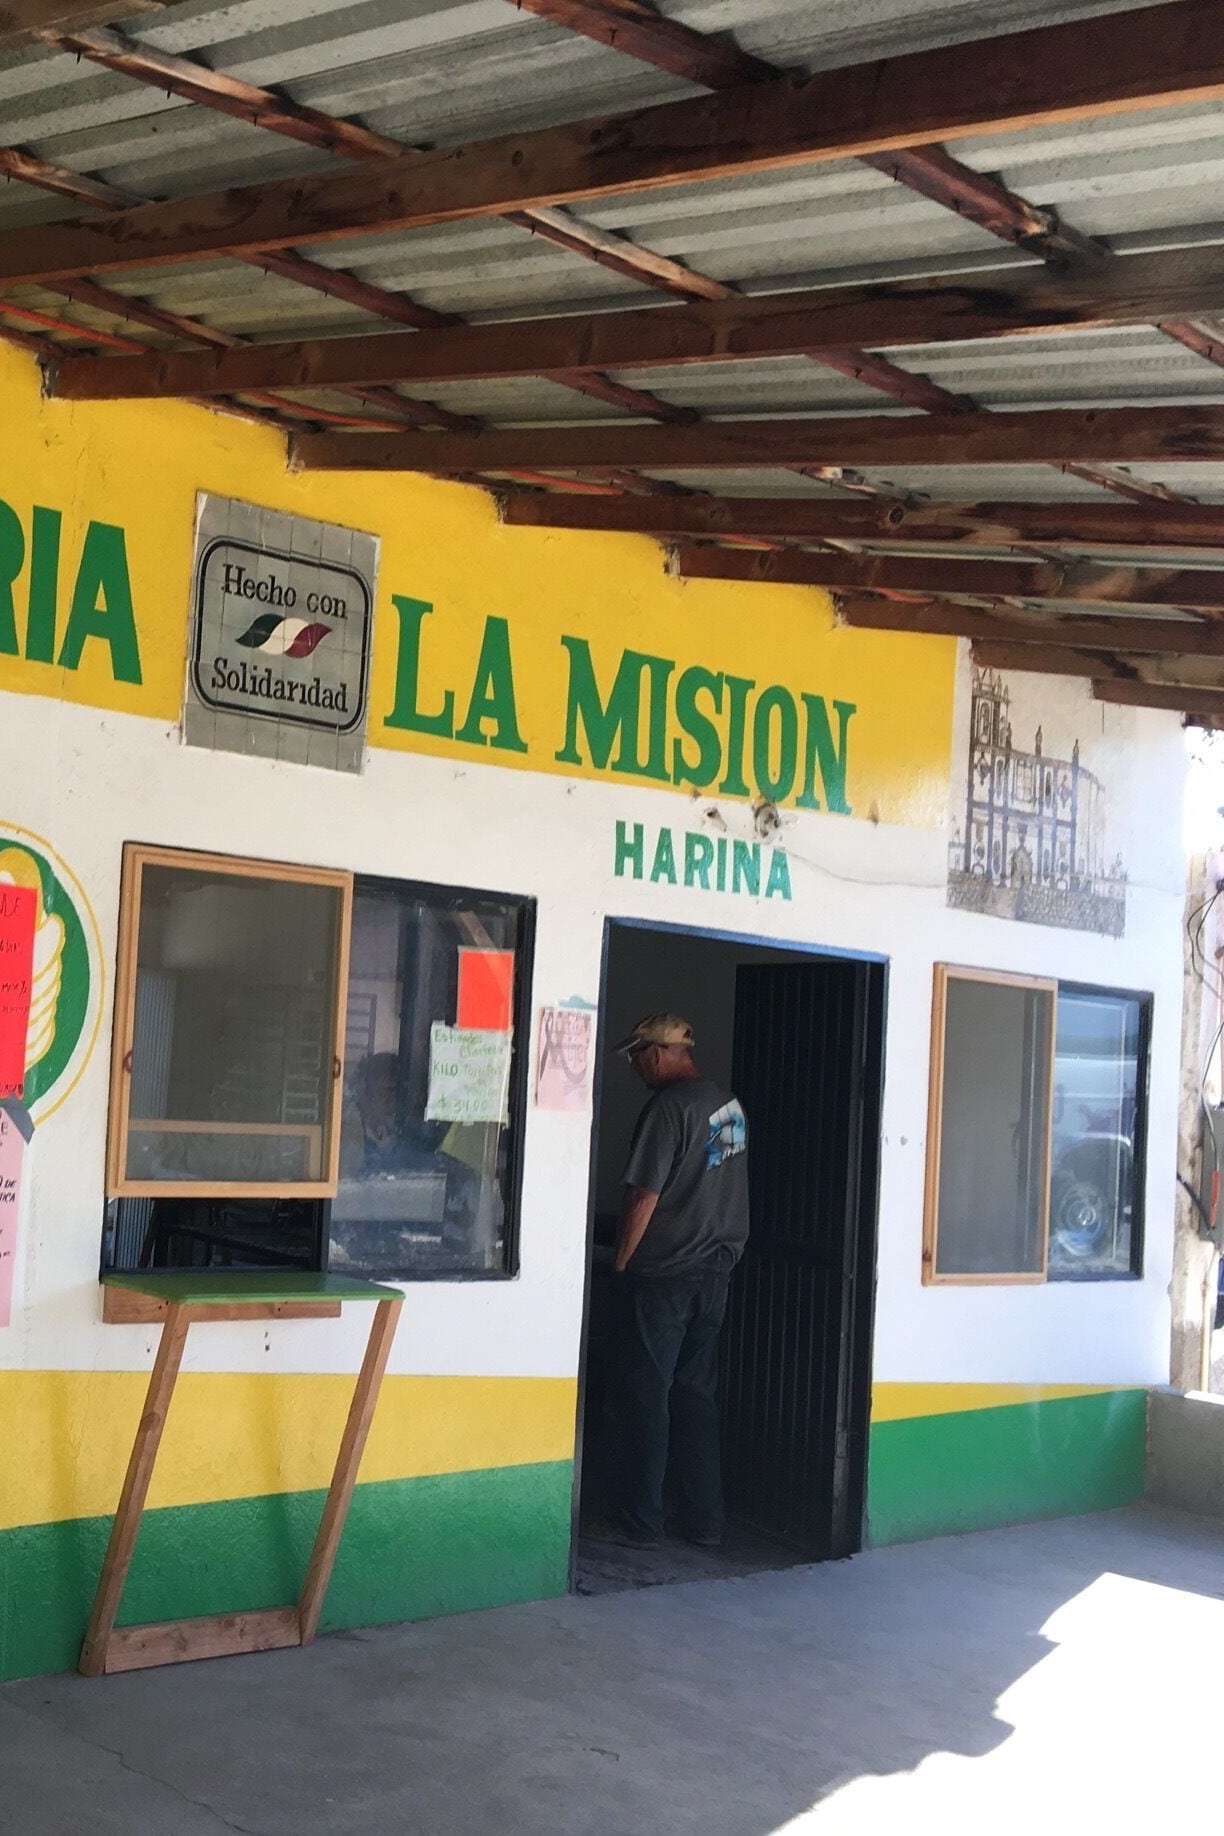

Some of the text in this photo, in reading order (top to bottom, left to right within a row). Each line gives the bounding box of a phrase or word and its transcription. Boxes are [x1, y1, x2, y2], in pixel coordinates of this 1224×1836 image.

[221, 563, 349, 619] Hecho con
[211, 657, 349, 713] Solidaridad
[383, 594, 857, 815] LA MISION
[614, 820, 792, 900] HARINA
[4, 1180, 16, 1189] DE
